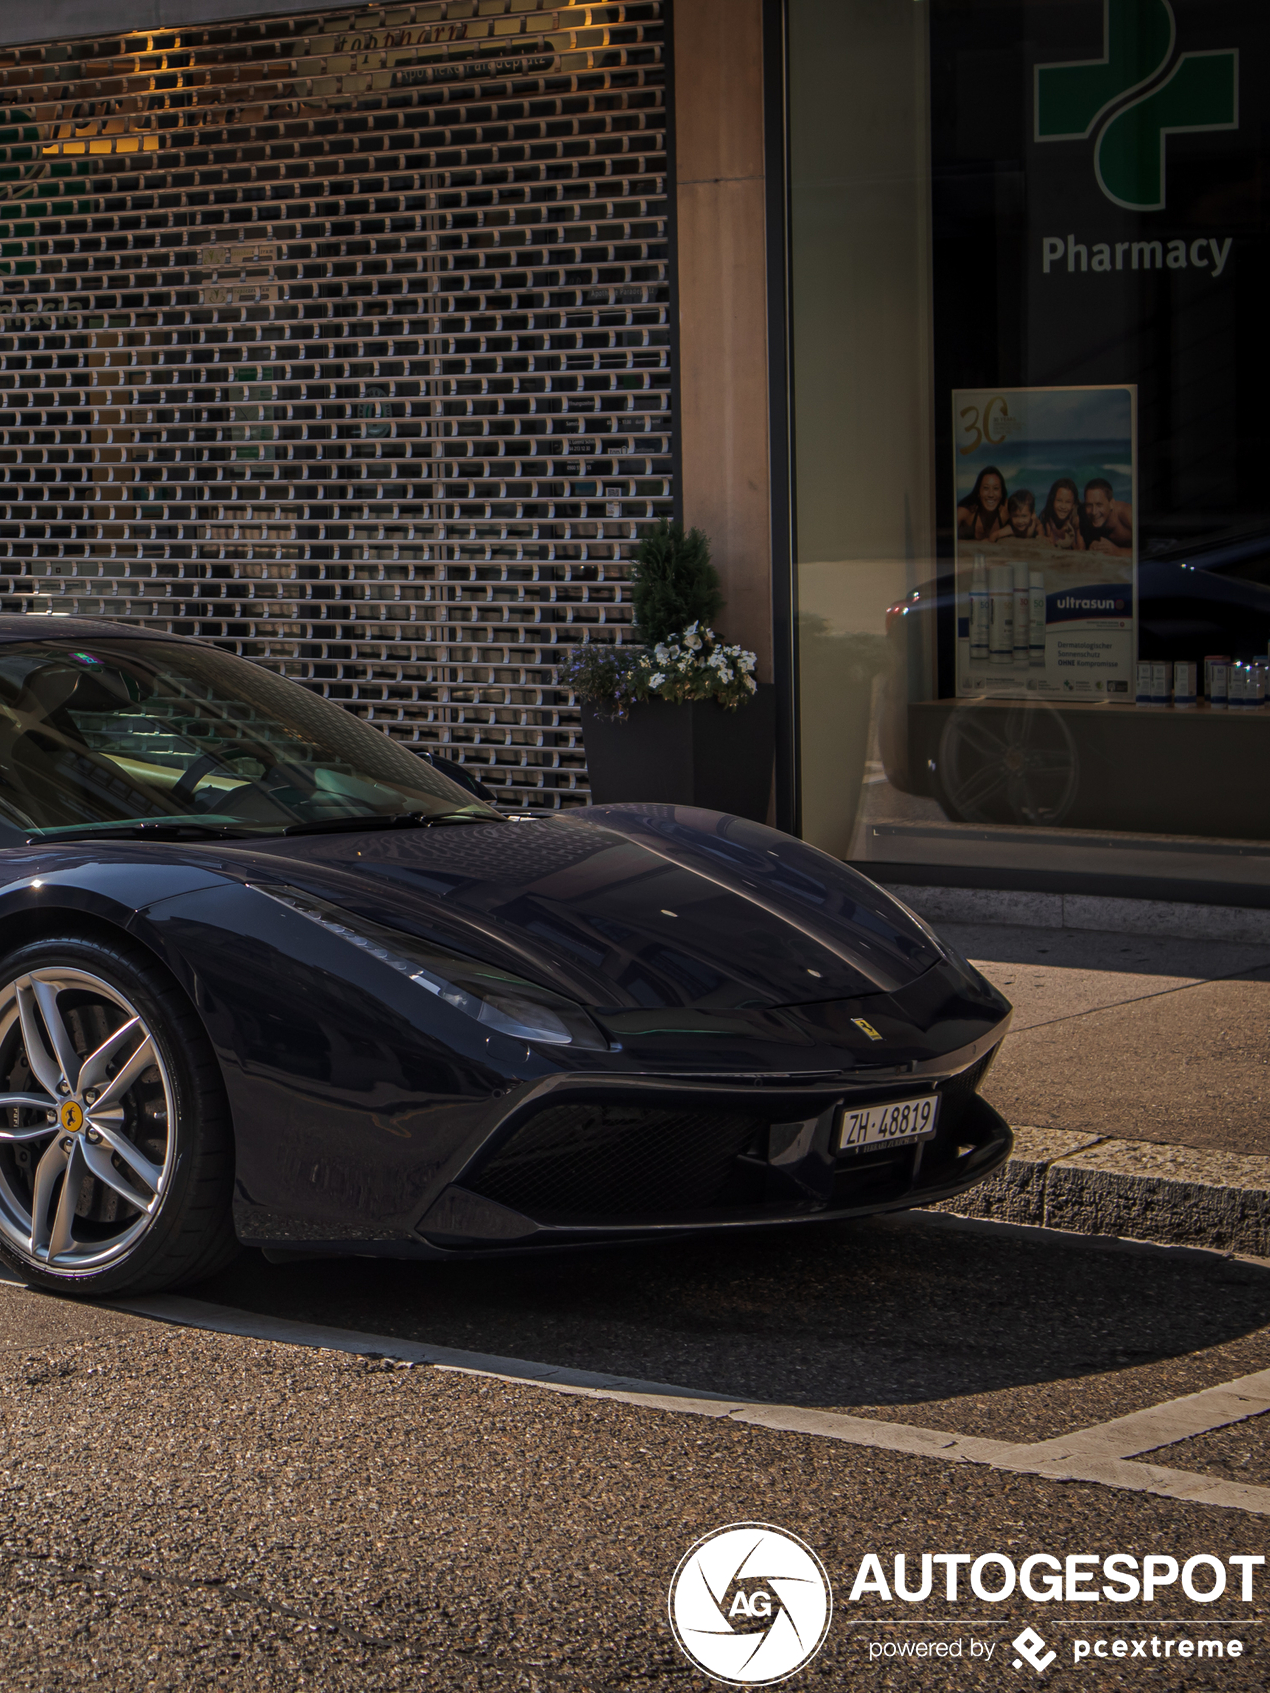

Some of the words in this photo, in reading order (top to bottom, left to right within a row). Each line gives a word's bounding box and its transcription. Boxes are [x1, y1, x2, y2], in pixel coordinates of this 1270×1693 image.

[465, 49, 546, 73] Paradepatz
[1042, 233, 1233, 278] Pharmacy
[959, 395, 1009, 456] 30
[1034, 599, 1045, 608] 50
[1056, 595, 1115, 610] ultrasun
[1057, 641, 1113, 651] Dermatologischer
[1057, 650, 1101, 658] Sonnenschutz
[1057, 659, 1075, 667] OHNE
[1076, 660, 1119, 668] Kompromisse
[863, 1140, 888, 1153] FERRARI
